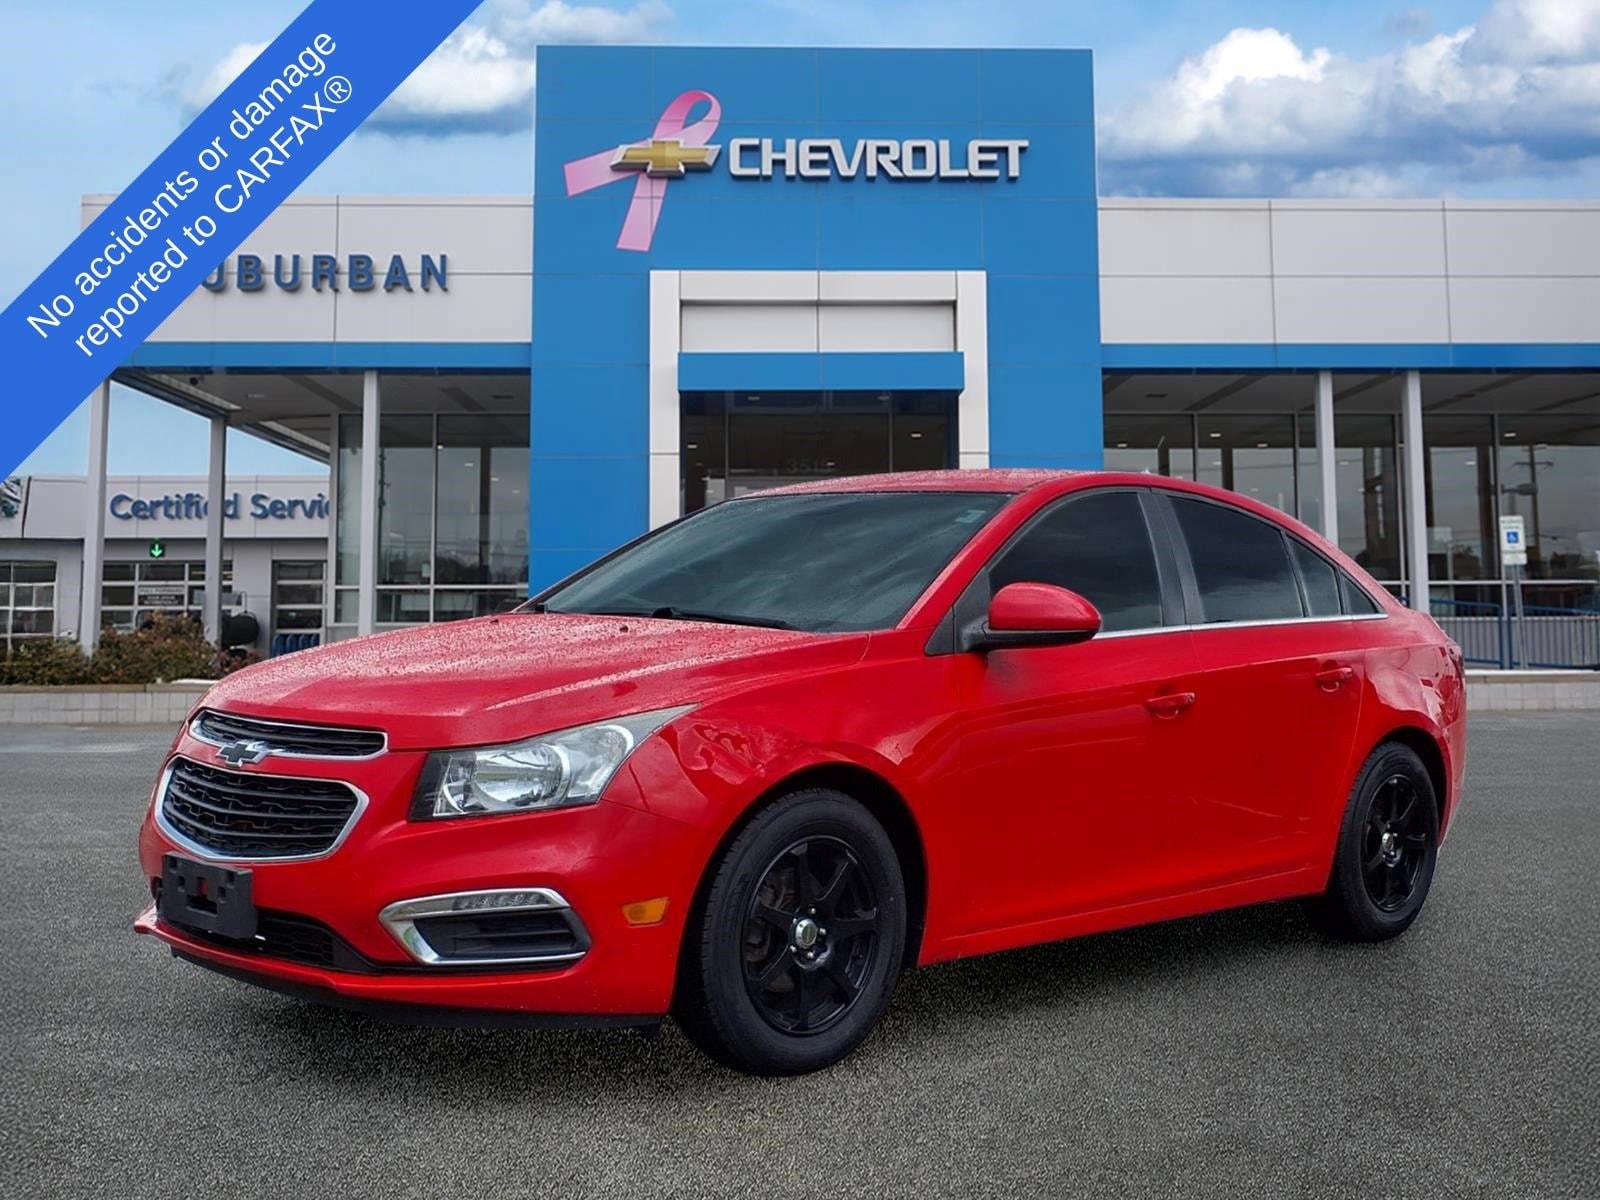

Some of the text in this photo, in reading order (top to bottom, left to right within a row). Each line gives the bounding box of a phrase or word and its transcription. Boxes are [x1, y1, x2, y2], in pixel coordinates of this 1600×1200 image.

[728, 137, 1029, 181] CHEVROLET
[201, 253, 449, 292] UBURBAN
[109, 492, 240, 520] Certifid
